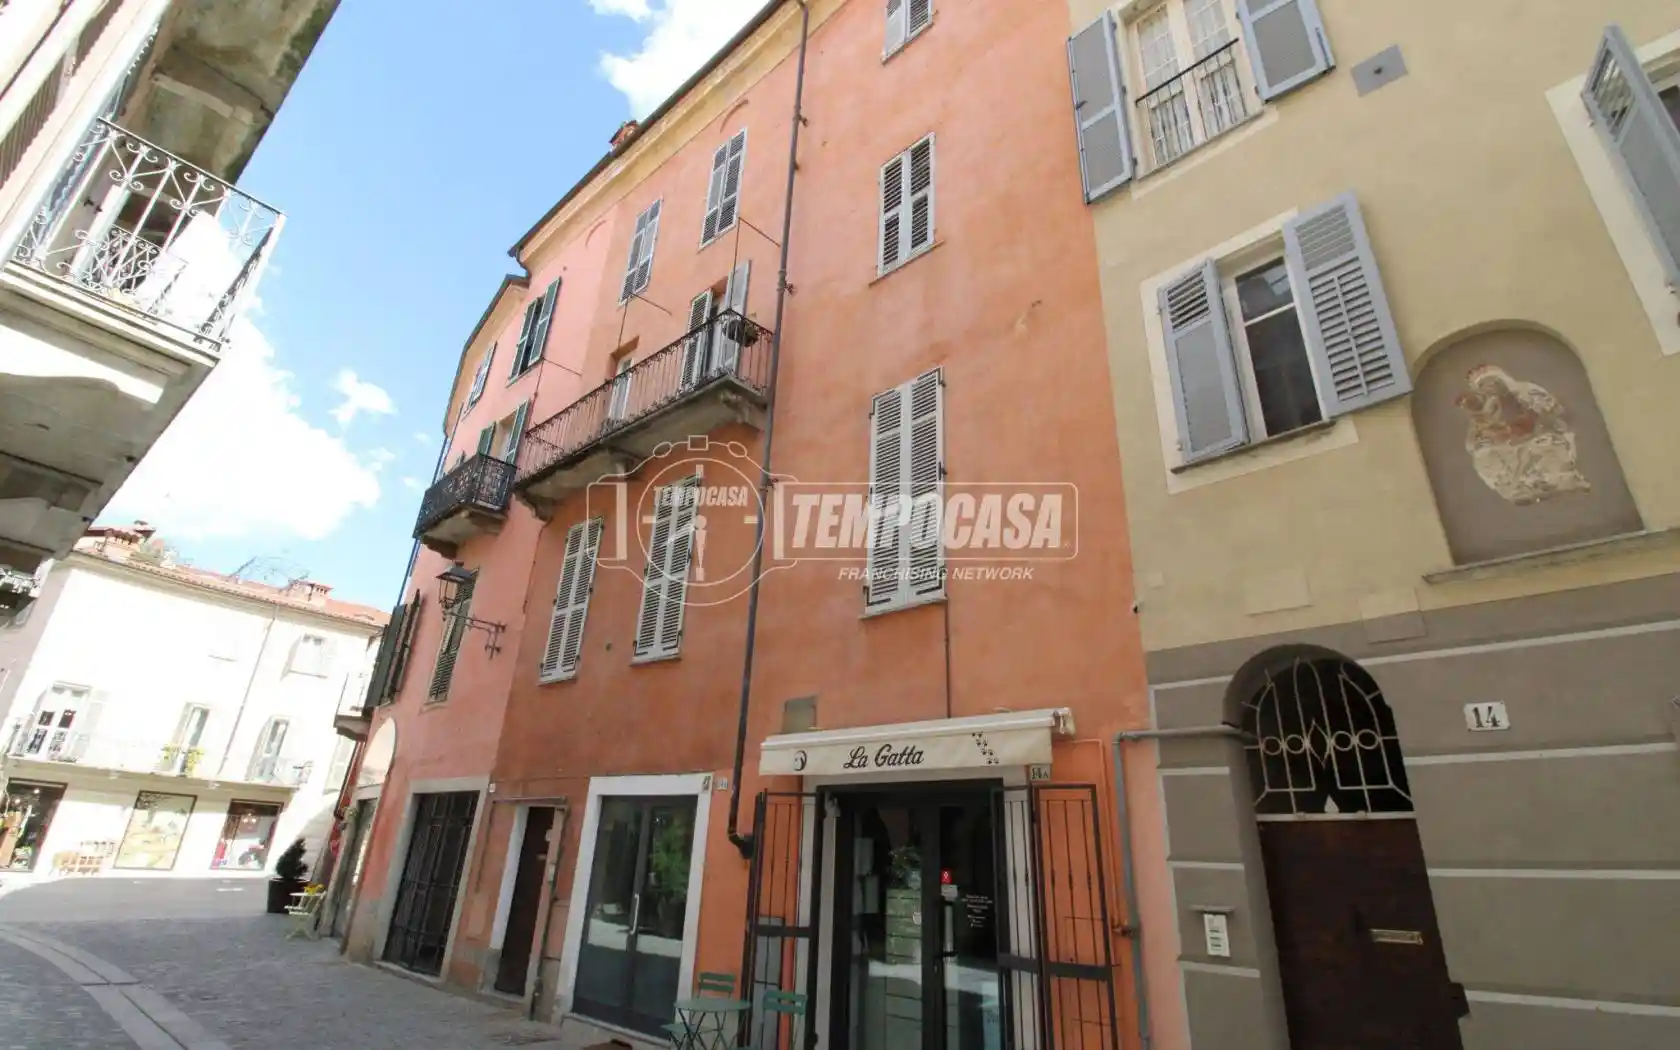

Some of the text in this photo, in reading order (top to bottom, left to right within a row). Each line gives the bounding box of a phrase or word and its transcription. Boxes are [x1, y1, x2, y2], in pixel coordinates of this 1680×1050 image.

[1472, 705, 1501, 728] 14
[843, 743, 924, 769] La Gatta
